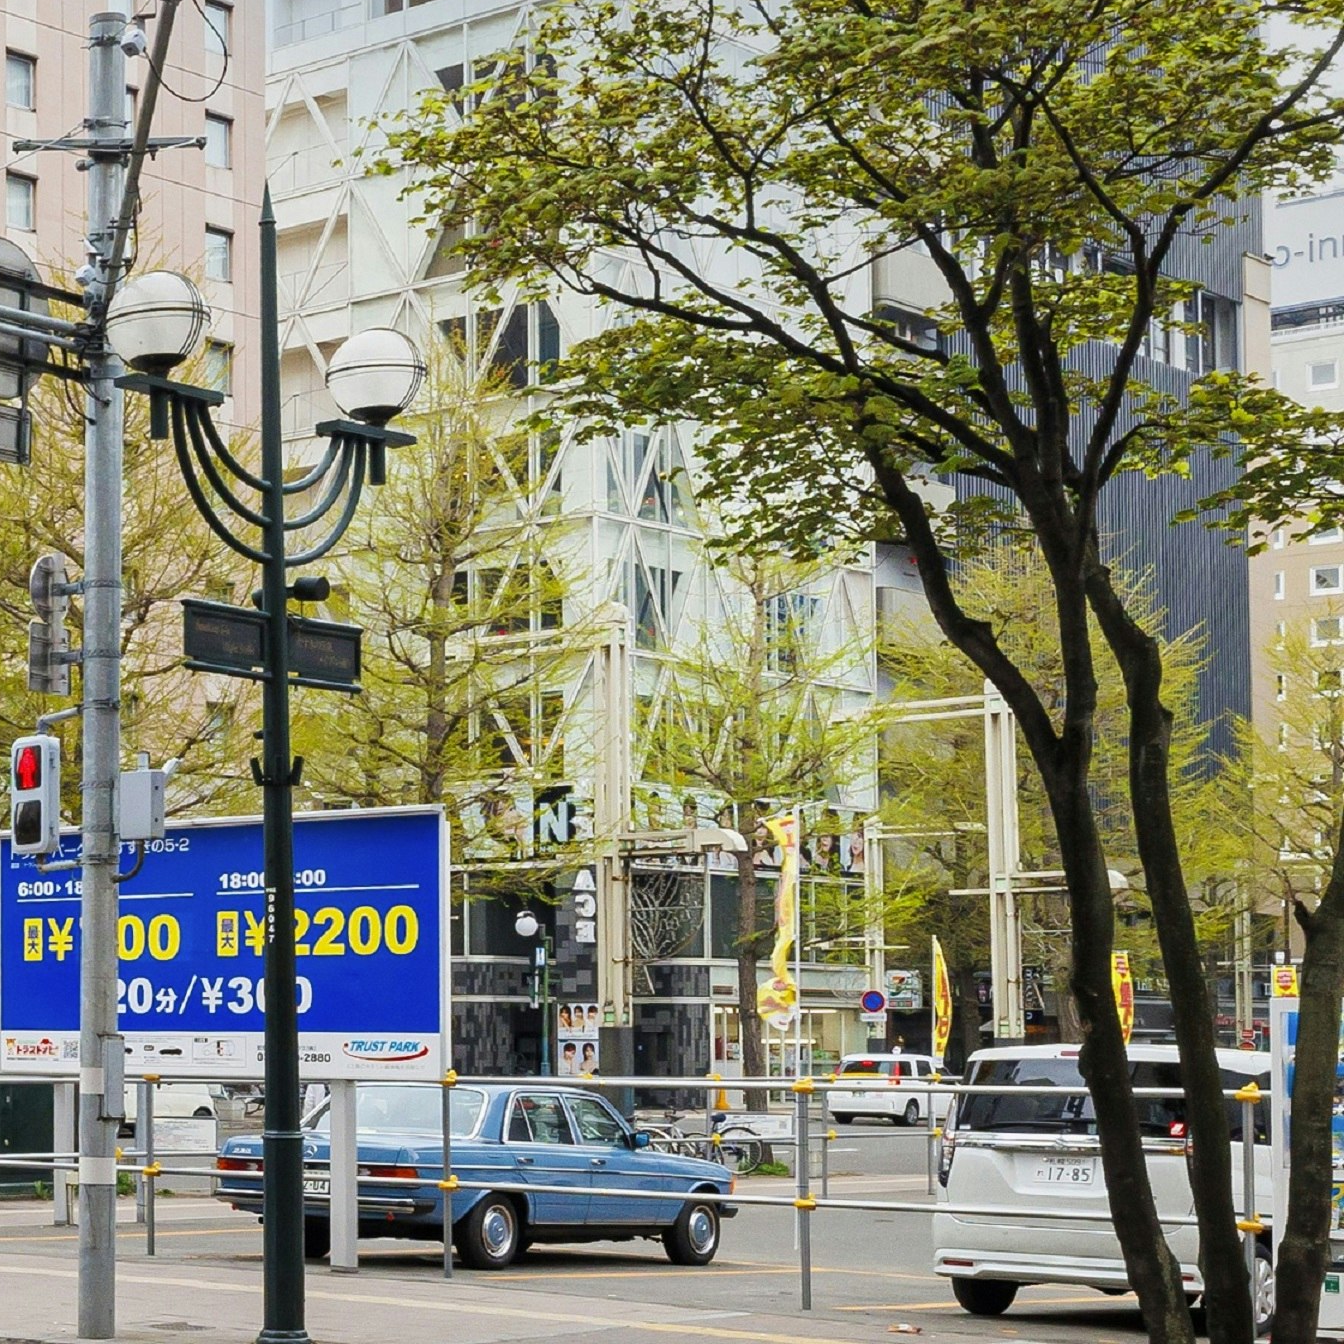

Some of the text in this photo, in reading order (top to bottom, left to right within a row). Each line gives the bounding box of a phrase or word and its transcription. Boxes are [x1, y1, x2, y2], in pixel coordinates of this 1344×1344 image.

[1273, 232, 1344, 268] o-in
[294, 869, 326, 886] :00
[17, 881, 54, 897] 6:00
[47, 914, 181, 962] ¥00
[348, 1040, 421, 1053] TRUST PARK
[1047, 1167, 1091, 1182] 17-85
